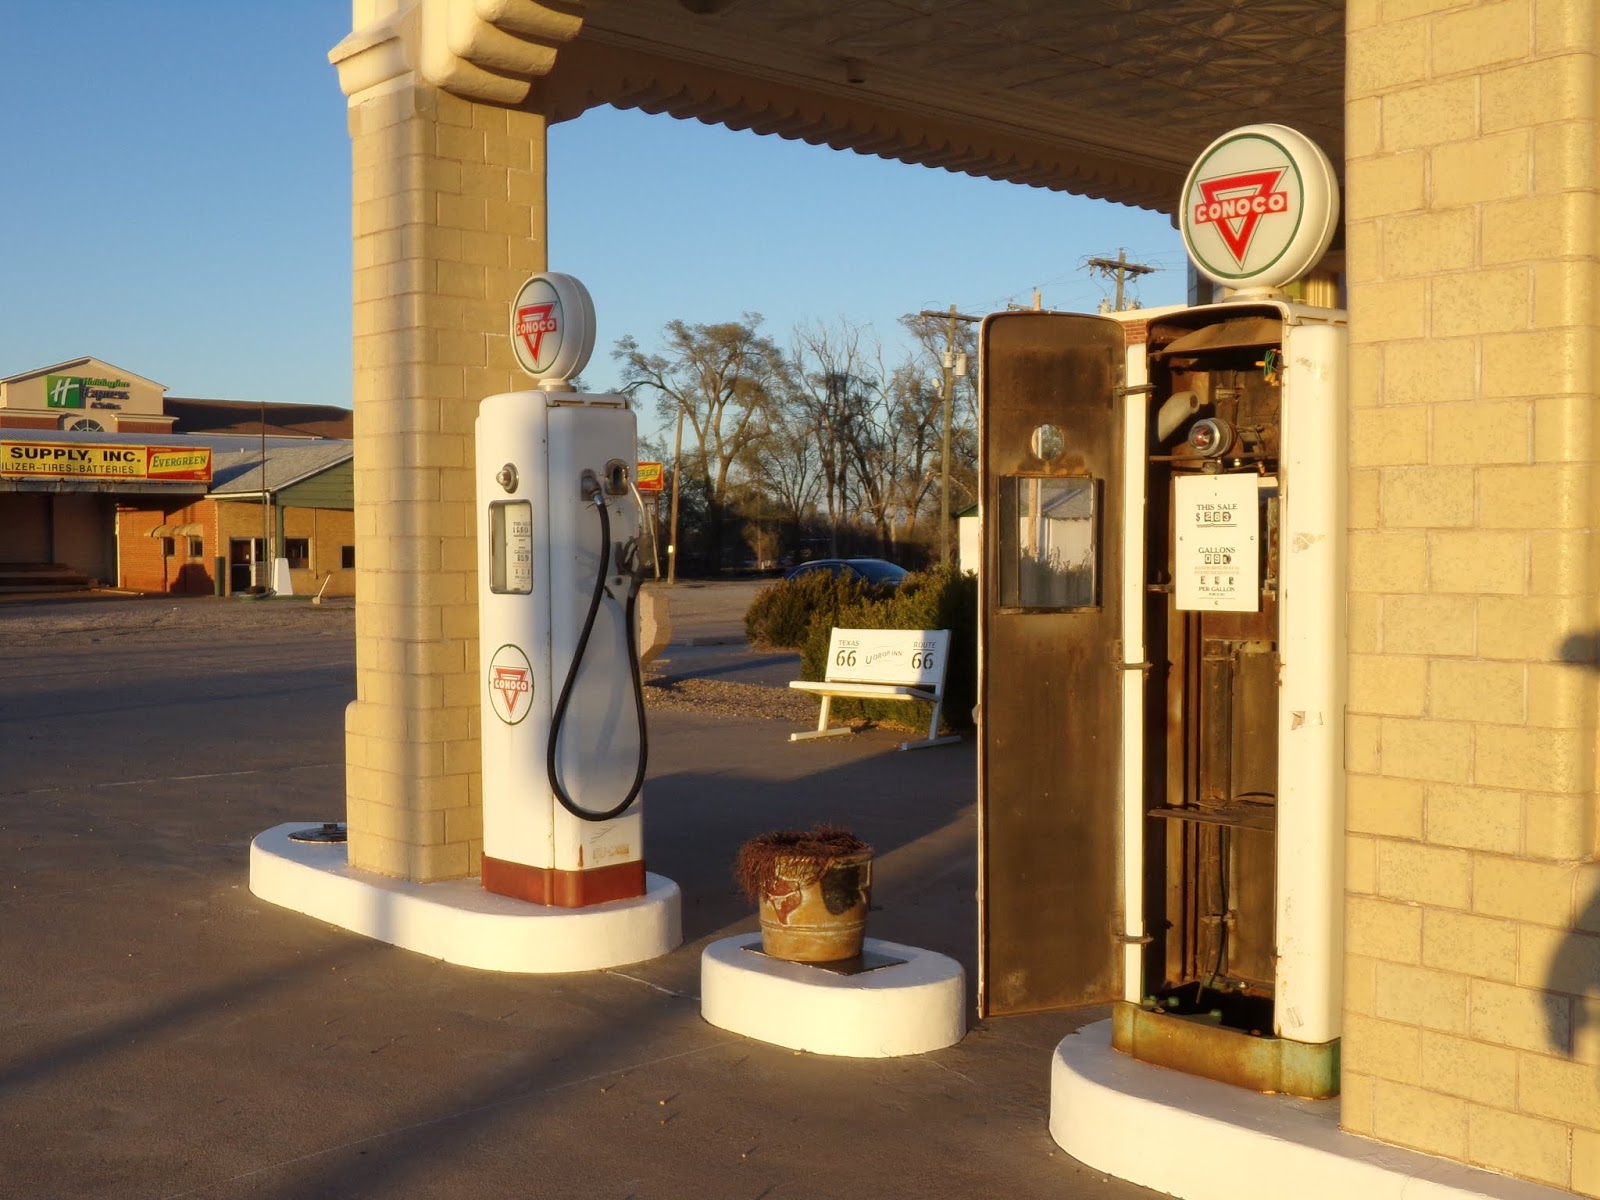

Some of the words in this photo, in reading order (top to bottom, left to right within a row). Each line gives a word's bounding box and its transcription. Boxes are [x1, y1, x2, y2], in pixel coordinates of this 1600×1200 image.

[1196, 193, 1285, 222] CONOCO
[516, 319, 556, 335] CONOCO
[10, 446, 92, 464] SUPPLY,
[103, 450, 142, 463] INC.
[1217, 503, 1238, 511] SALE
[1198, 546, 1236, 554] GALLONS
[836, 649, 857, 667] 66
[911, 652, 934, 670] 66
[494, 679, 528, 692] CONOCO
